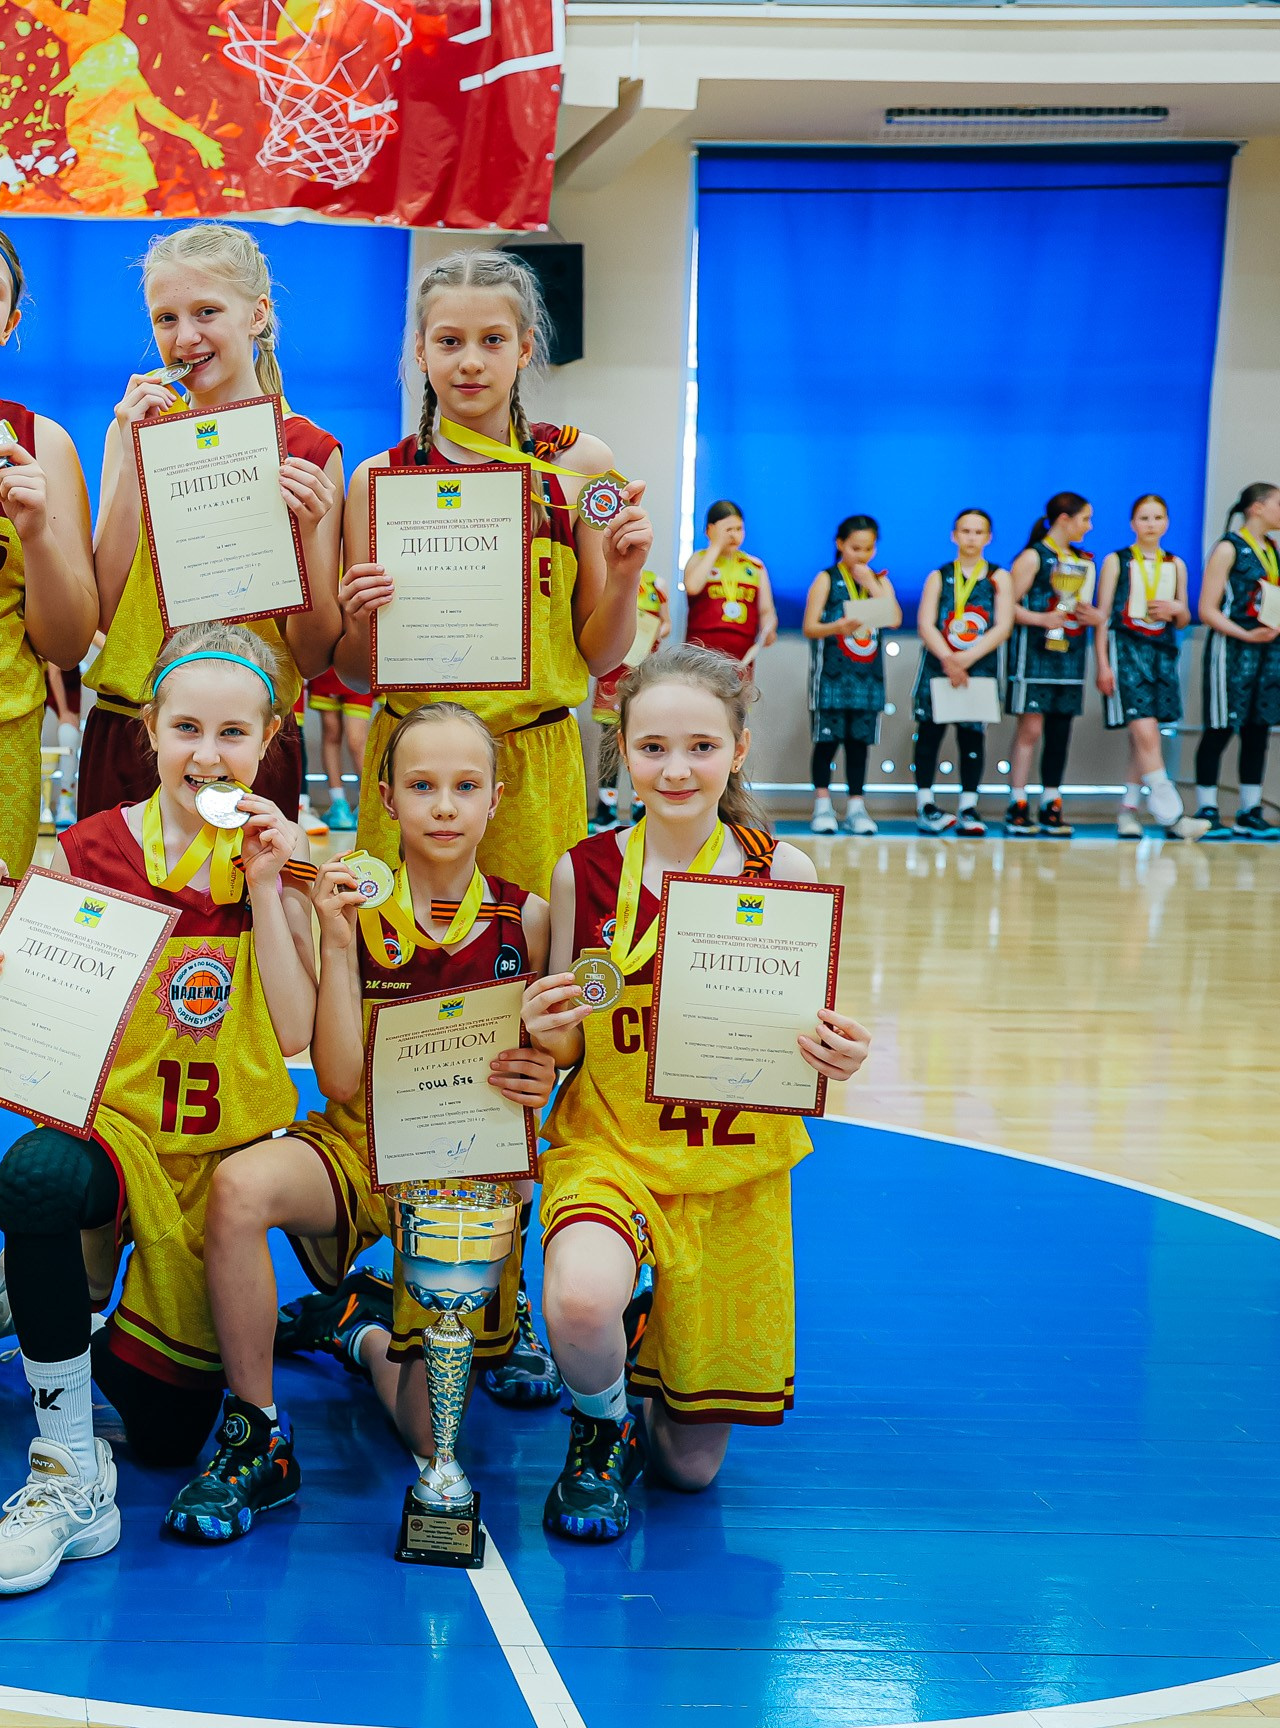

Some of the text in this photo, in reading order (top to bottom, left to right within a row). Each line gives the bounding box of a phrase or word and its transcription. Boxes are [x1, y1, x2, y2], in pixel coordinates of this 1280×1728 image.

[171, 465, 259, 500] ДИПЛОМ
[186, 495, 250, 512] НАГРАЖДАЕТСЯ
[401, 535, 498, 556] ДИПЛОМ
[17, 937, 116, 980] ДИПЛОМ
[689, 951, 800, 976] ДИПЛОМ
[591, 962, 598, 973] 1
[24, 967, 91, 994] НАГРАЖДАЕТСЯ
[381, 982, 412, 990] SPORT
[171, 985, 231, 1002] НАДЕЖДА
[705, 984, 783, 996] НАГРАЖДАЕТСЯ
[178, 1007, 224, 1024] ОРЕНБУРЖЬЕ
[399, 1030, 497, 1061] ДИПЛОМ
[413, 1055, 483, 1071] НАГРАЖДАЕТСЯ
[157, 1059, 220, 1135] 13
[32, 1458, 56, 1468] ANTA
